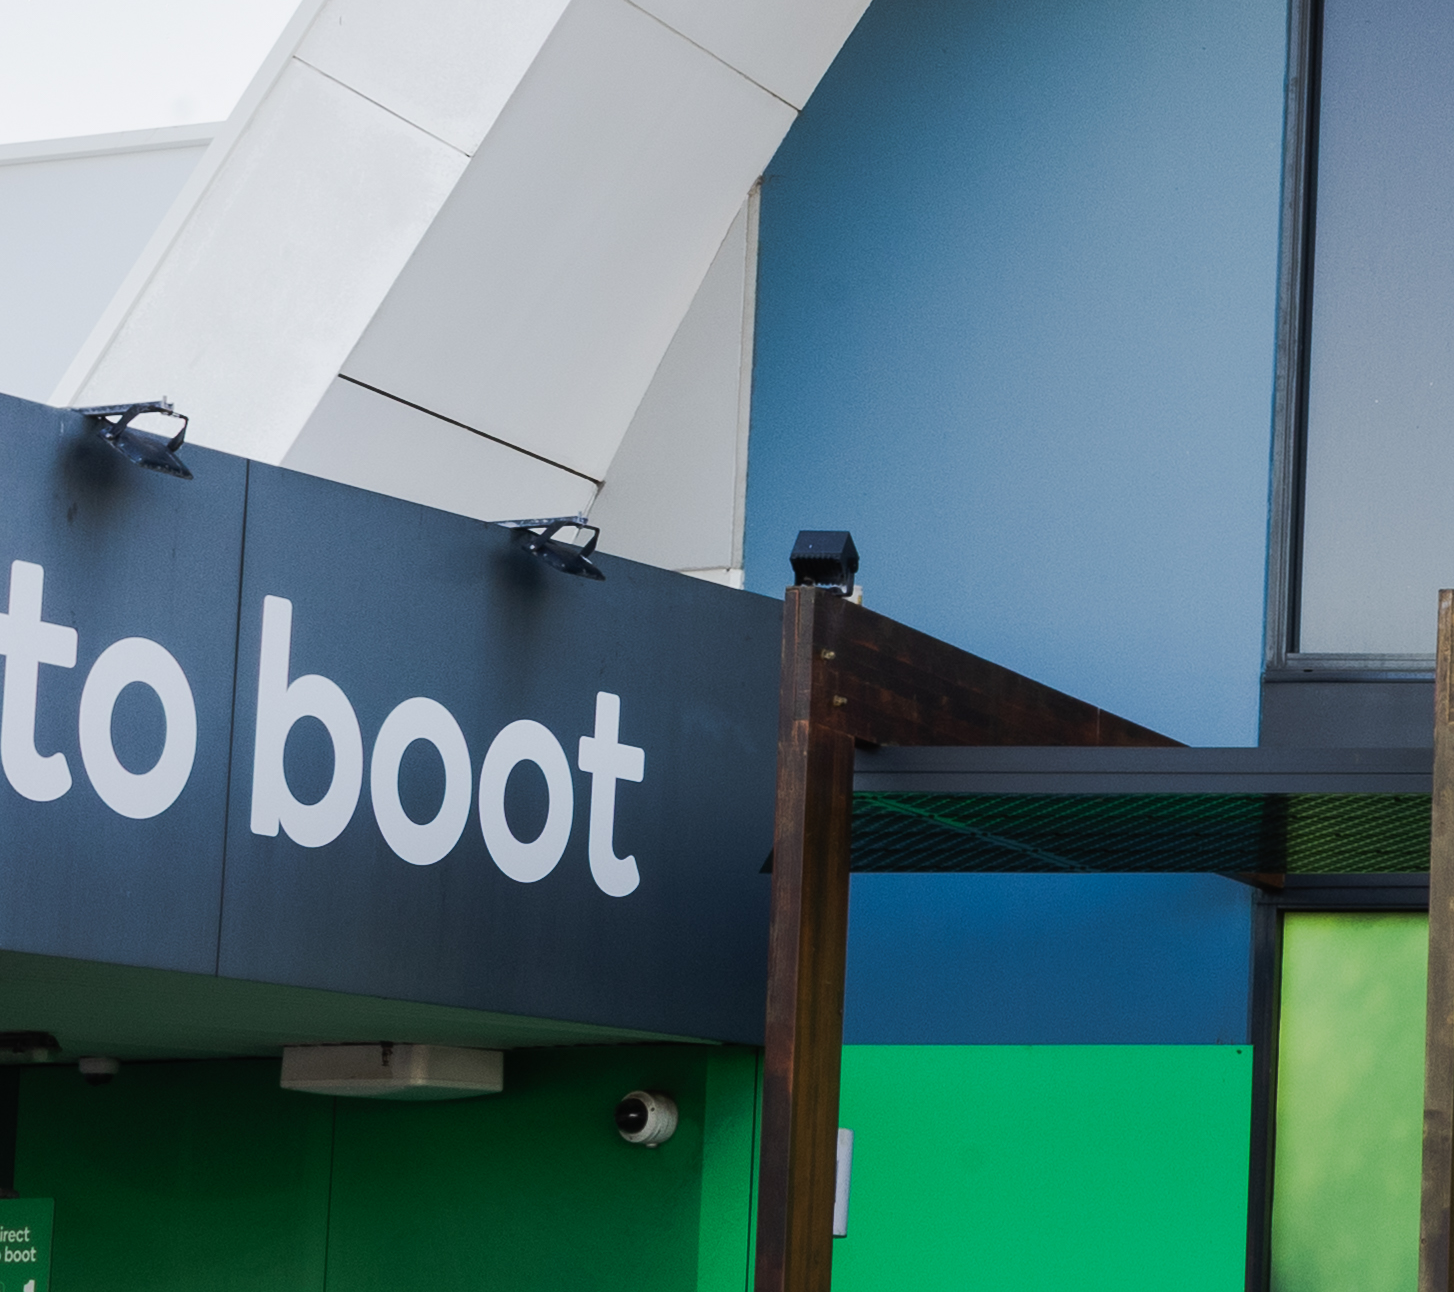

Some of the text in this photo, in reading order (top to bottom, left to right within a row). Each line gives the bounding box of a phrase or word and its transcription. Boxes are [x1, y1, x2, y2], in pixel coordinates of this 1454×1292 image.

[0, 559, 645, 897] to boot
[0, 1226, 31, 1242] irect
[4, 1246, 37, 1262] boot
